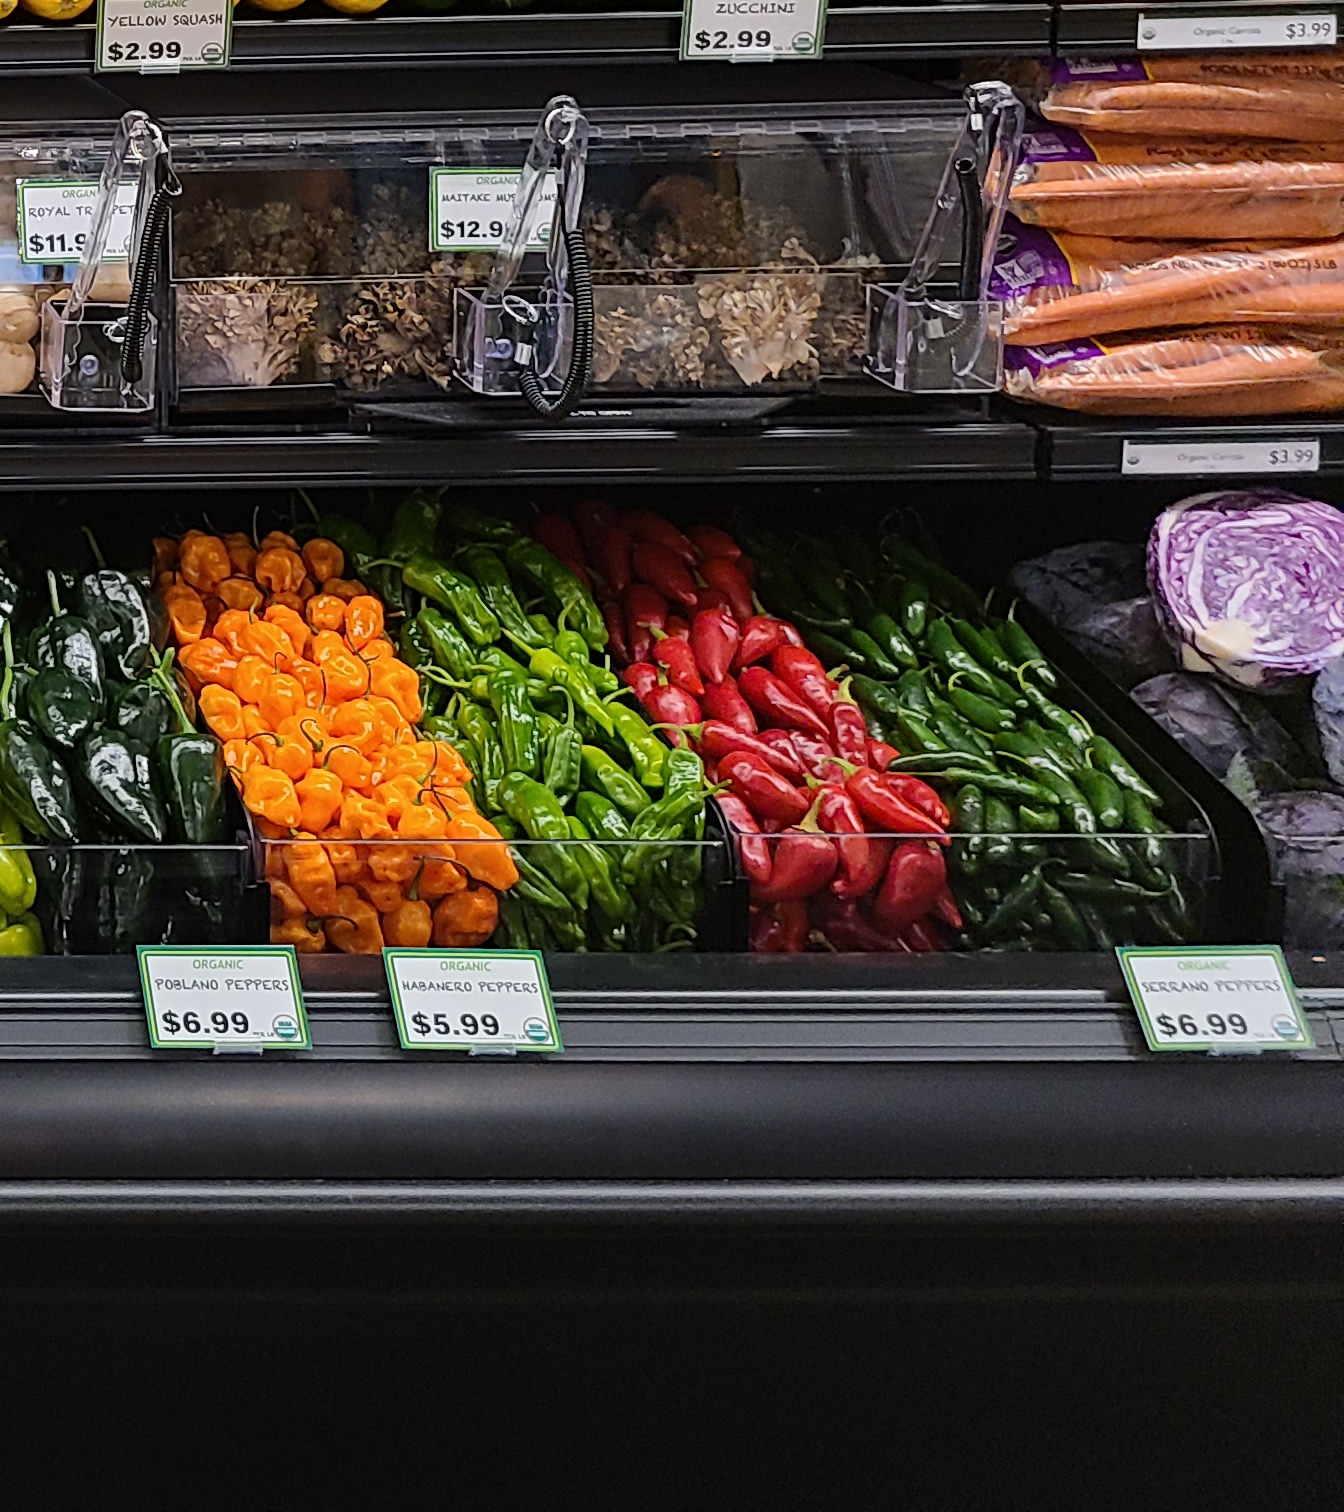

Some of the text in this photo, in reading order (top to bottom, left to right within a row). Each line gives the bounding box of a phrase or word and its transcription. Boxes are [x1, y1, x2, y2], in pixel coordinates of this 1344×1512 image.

[716, 2, 796, 14] ZUCCHINI
[107, 14, 223, 27] YELLOW SQUASH
[1285, 21, 1331, 39] $3.99
[694, 30, 771, 51] $2.99
[108, 42, 181, 62] $2.99
[442, 194, 491, 202] MAITAKE
[29, 206, 71, 218] ROYAL
[155, 979, 289, 991] POBLANO PEPPERS
[402, 981, 538, 994] HABANERO PEPPERS
[1141, 980, 1281, 993] SERRANO PEPPERS
[162, 1010, 249, 1035] $6.99
[411, 1011, 499, 1037] $5.99
[1156, 1013, 1248, 1038] $6.99
